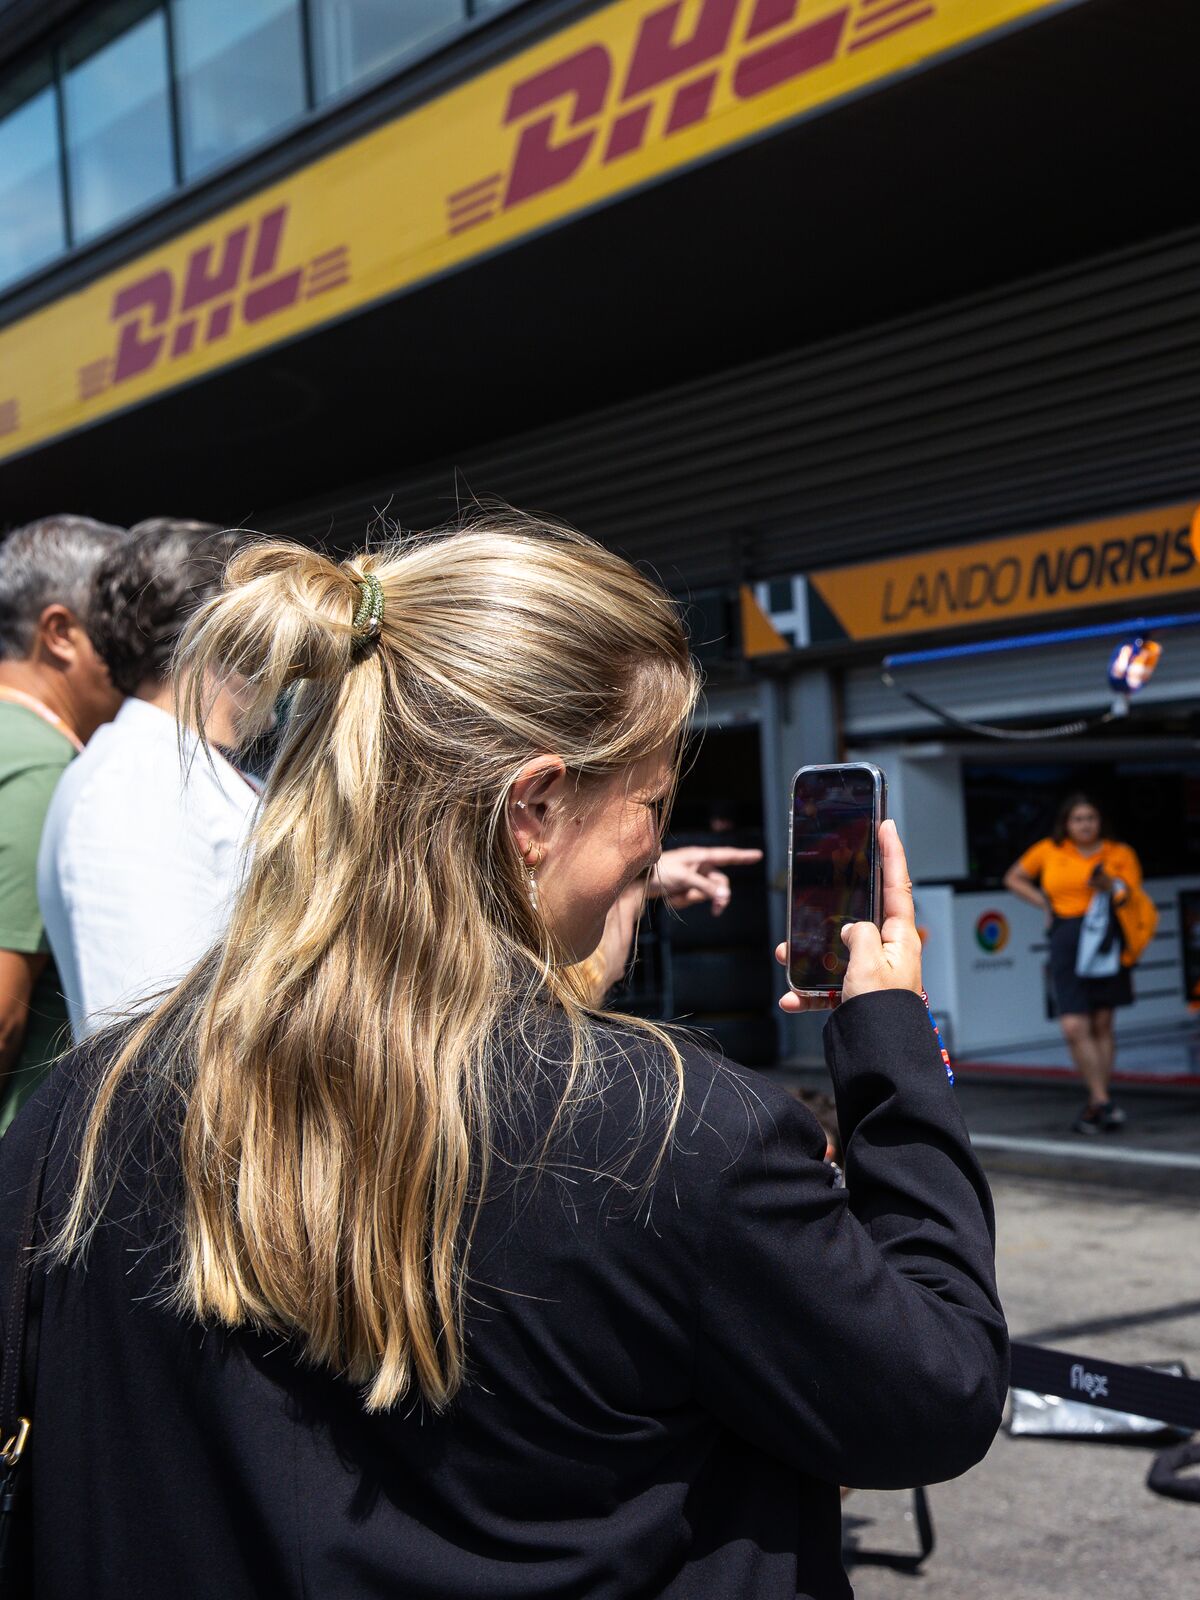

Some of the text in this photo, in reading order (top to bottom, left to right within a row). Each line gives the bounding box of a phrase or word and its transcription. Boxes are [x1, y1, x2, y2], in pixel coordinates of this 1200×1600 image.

[502, 0, 853, 213] DHL
[111, 202, 304, 385] DHL
[881, 556, 1022, 623] LANDO
[1029, 525, 1197, 598] NORRIS
